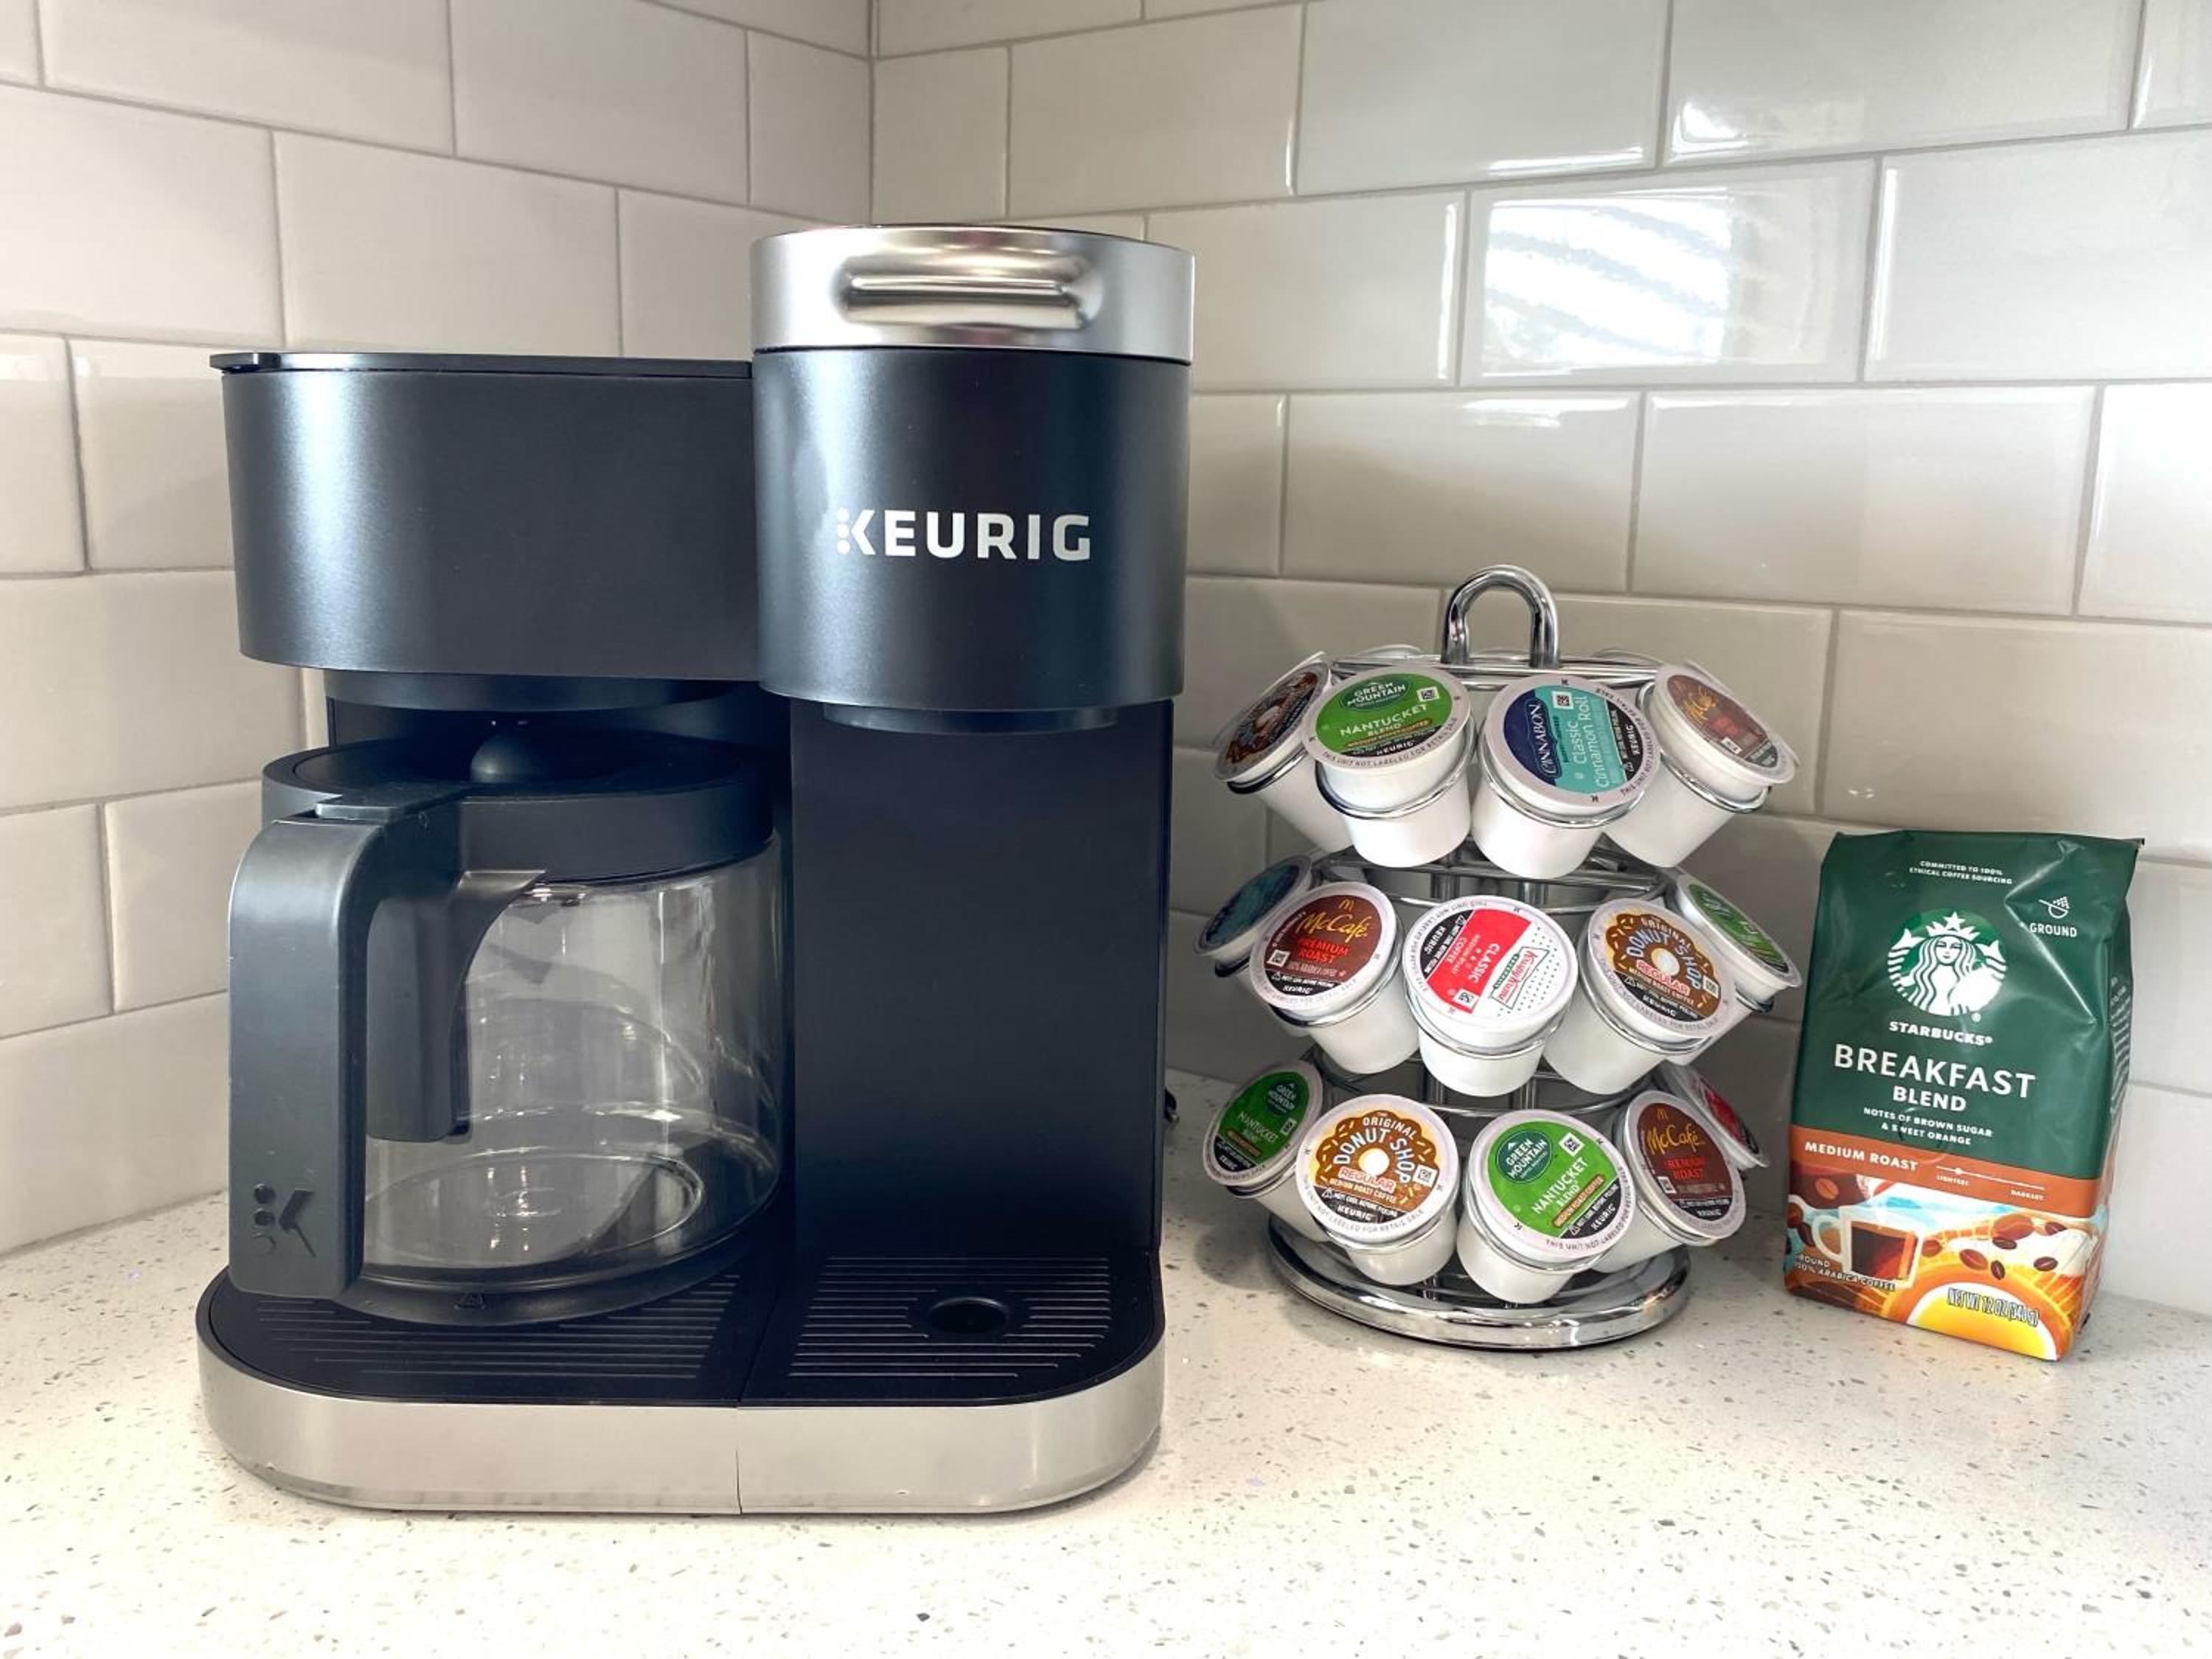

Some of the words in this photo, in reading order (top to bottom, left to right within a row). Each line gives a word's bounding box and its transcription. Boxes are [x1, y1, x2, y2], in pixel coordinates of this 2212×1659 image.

[836, 507, 1091, 561] KEURIG
[1347, 684, 1407, 706] MOUNTAIN
[1354, 682, 1394, 698] GREEN
[1340, 703, 1428, 737] NANTUCKET
[1575, 695, 1592, 721] Roll
[1528, 703, 1557, 774] CINNABON
[1565, 720, 1587, 765] Classic
[1625, 725, 1641, 755] KEURIG
[1583, 724, 1610, 788] Cinnamon
[1909, 867, 1941, 877] ETHICAL
[1941, 871, 1970, 880] COFFEE
[1972, 874, 2013, 885] SOURCING
[1919, 860, 1966, 872] COMMITTED
[1980, 867, 2003, 876] 100%
[1424, 925, 1446, 954] KEURIG
[1641, 917, 1692, 949] ORIGINAL
[2030, 922, 2077, 937] GROUND
[1297, 938, 1350, 956] PREMIUM
[1298, 947, 1337, 964] ROAST
[1447, 937, 1467, 964] COFFEE
[1626, 929, 1671, 958] DONUT
[1674, 944, 1703, 990] SHOP
[1468, 943, 1500, 984] CLASSIC
[1636, 959, 1691, 996] REGULAR
[1834, 1043, 2036, 1099] BREAKFAST
[1893, 1085, 1966, 1112] BLEND
[1238, 1111, 1279, 1143] NANTUCKET
[1363, 1116, 1418, 1141] ORIGINAL
[1863, 1107, 1896, 1121] NOTES
[1898, 1113, 1911, 1123] OF
[1914, 1116, 1954, 1131] BROWN
[1956, 1124, 1993, 1138] SUGAR
[1881, 1122, 1888, 1130] &
[1927, 1131, 1971, 1145] ORANGE
[1333, 1127, 1391, 1165] DONUT
[1390, 1138, 1416, 1183] SHOP
[1506, 1138, 1534, 1166] GREEN
[1507, 1139, 1548, 1179] MOUNTAIN
[1804, 1141, 1865, 1161] MEDIUM
[1870, 1151, 1918, 1172] ROAST
[1338, 1166, 1397, 1193] REGULAR
[1531, 1157, 1588, 1214] NANTUCKET
[1374, 1189, 1397, 1203] COFFEE
[1556, 1184, 1580, 1207] BLEND
[1338, 1205, 1373, 1221] KEURIG
[1591, 1203, 1616, 1230] KEURIG
[1817, 1267, 1858, 1283] ARABICA
[1860, 1276, 1896, 1290] COFFEE
[1947, 1287, 1965, 1308] NET
[1965, 1292, 1981, 1311] WT
[1982, 1295, 1994, 1314] 12
